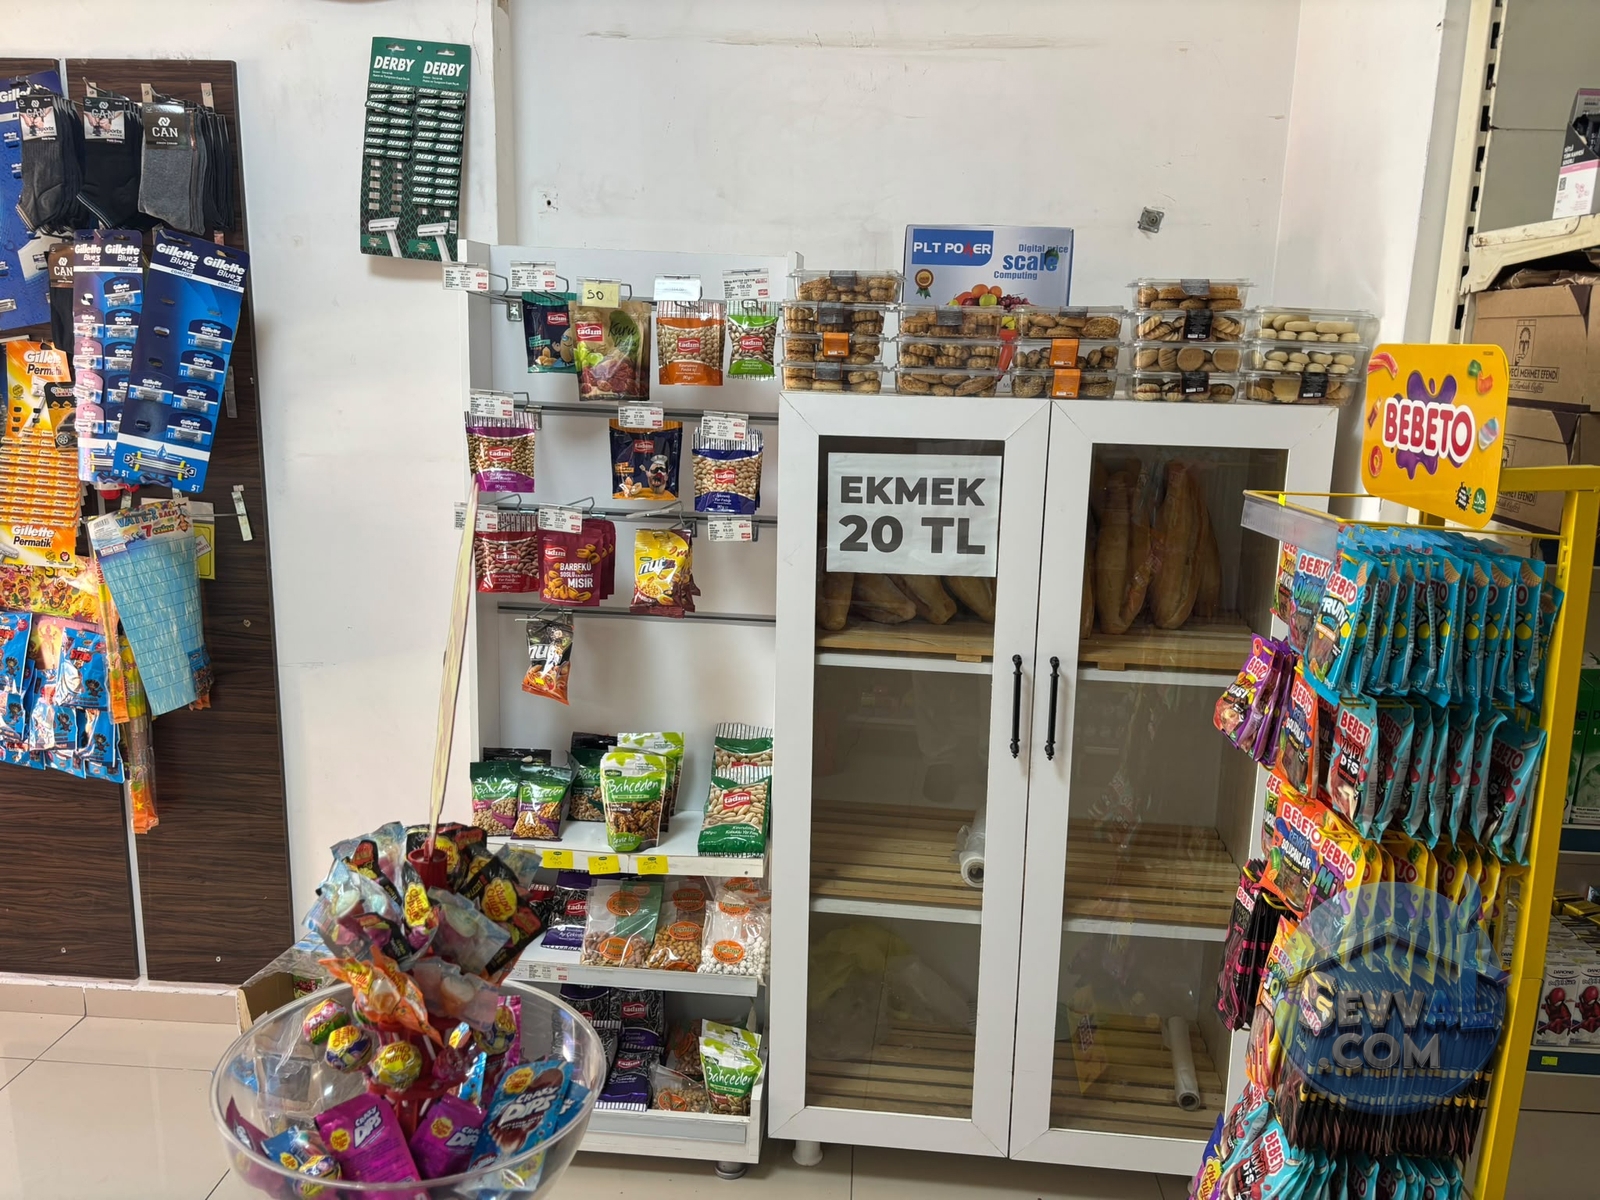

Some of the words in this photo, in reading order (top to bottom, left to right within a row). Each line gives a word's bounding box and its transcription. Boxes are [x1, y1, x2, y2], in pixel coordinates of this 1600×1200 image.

[374, 56, 415, 72] DERBY
[423, 61, 464, 77] DERBY
[92, 108, 115, 119] CAN
[366, 101, 387, 109] DERBY
[389, 106, 408, 115] DERBY
[417, 107, 436, 115] DERBY
[152, 127, 178, 138] CAN
[75, 244, 101, 254] Gillette
[105, 244, 140, 255] Gillette
[156, 243, 199, 262] Gillette
[913, 242, 941, 254] PLT
[1018, 244, 1044, 254] Digital
[203, 256, 245, 276] Gillette
[1002, 252, 1058, 272] scale
[54, 266, 73, 277] CAN
[994, 270, 1038, 281] Computing
[577, 327, 602, 336] tadım
[1520, 370, 1540, 379] MEHMET
[1384, 401, 1474, 459] BEBETO
[841, 475, 986, 507] EKMEK
[11, 525, 55, 538] Gillette
[141, 524, 152, 537] 7
[838, 514, 904, 553] 20
[921, 516, 986, 555] TL
[13, 536, 52, 548] Permatik
[1340, 709, 1370, 746] BEBET
[607, 778, 659, 794] Bahçeden
[724, 795, 749, 804] tadım
[1283, 803, 1322, 845] BEBETO
[1320, 838, 1355, 880] BEBETO
[516, 1086, 559, 1104] CRAZY
[498, 1095, 556, 1127] DIPS
[354, 1111, 382, 1148] DIPS
[462, 1126, 480, 1135] CRA
[1206, 1163, 1216, 1185] Chu
